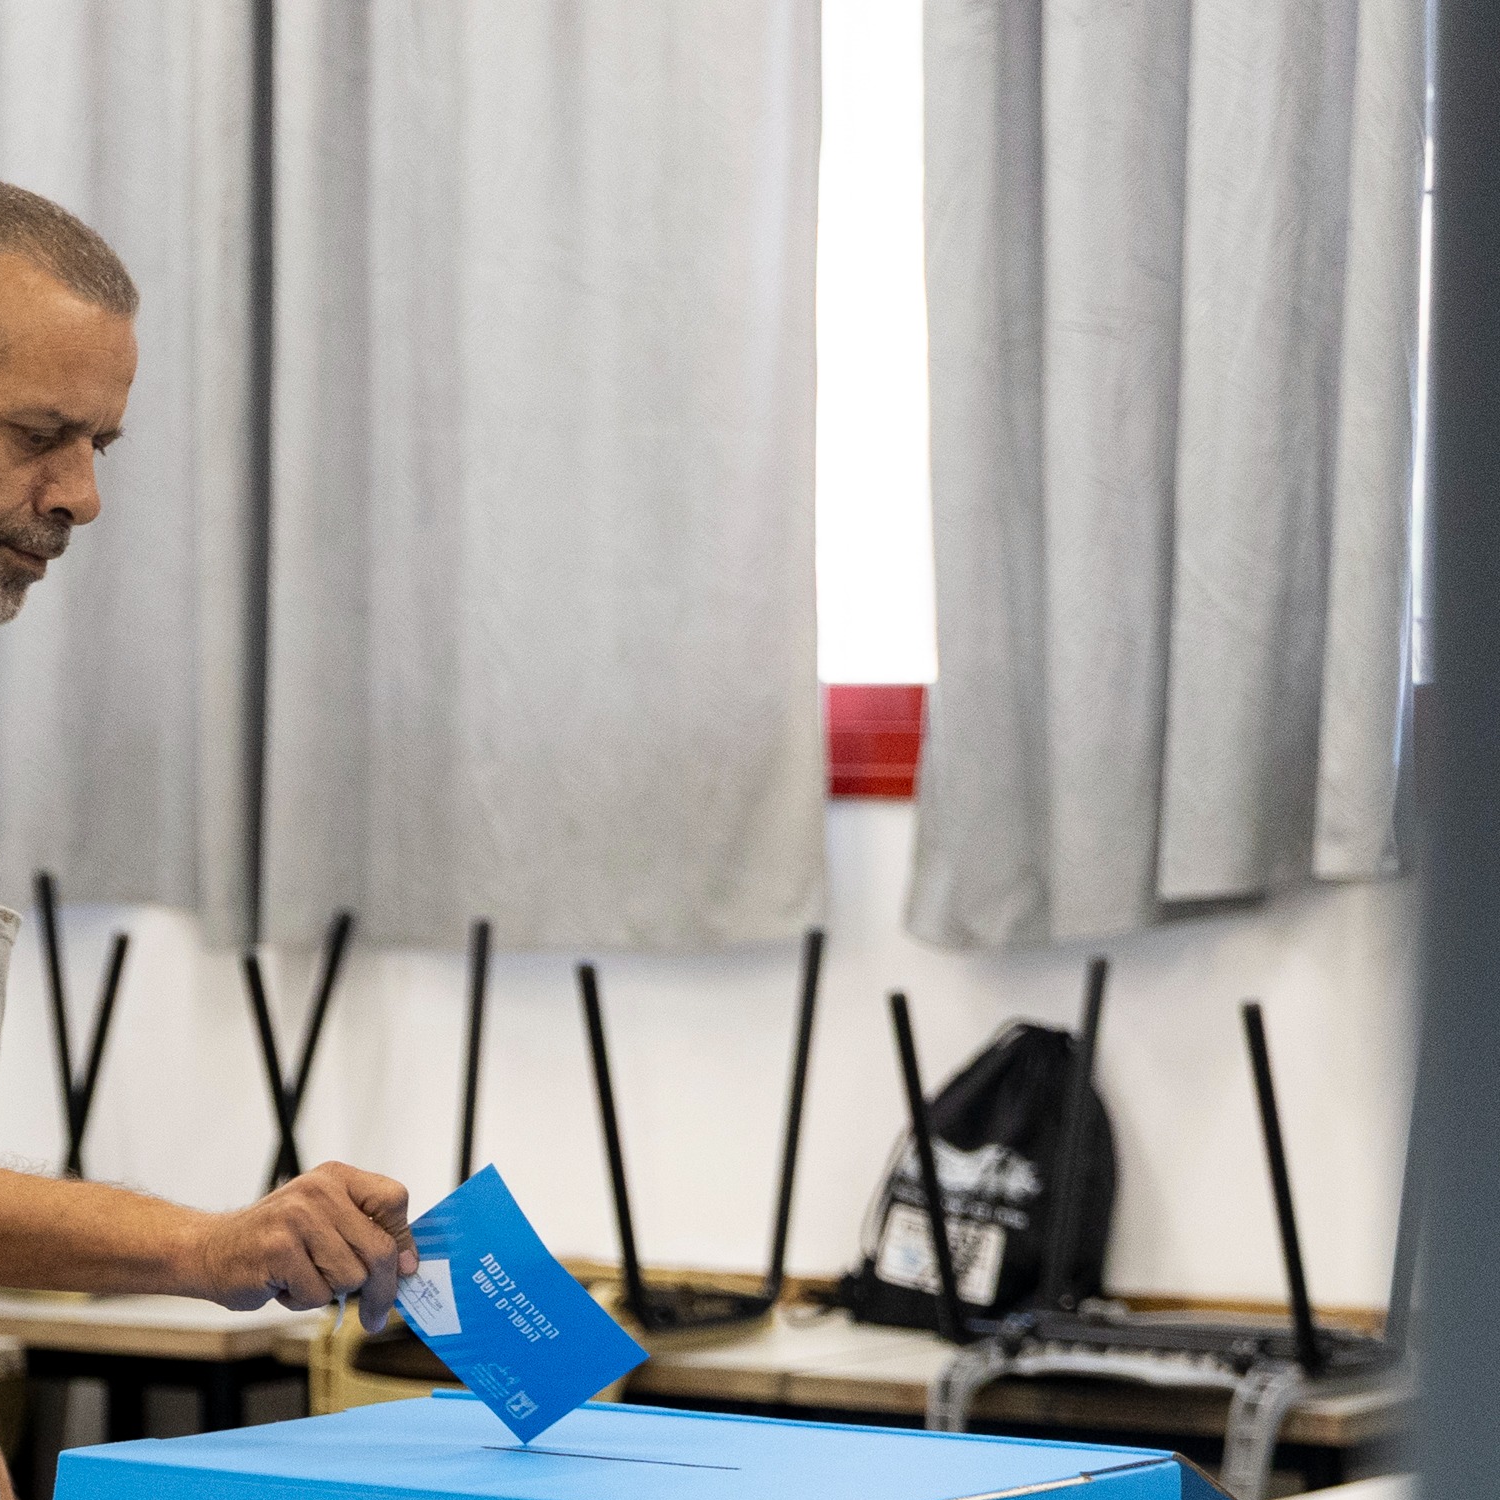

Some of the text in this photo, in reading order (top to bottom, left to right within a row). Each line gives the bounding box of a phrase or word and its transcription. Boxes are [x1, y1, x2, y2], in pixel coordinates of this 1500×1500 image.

[472, 1269, 541, 1343] העשרים ושש
[480, 1253, 559, 1339] הבחירות לכנסת
